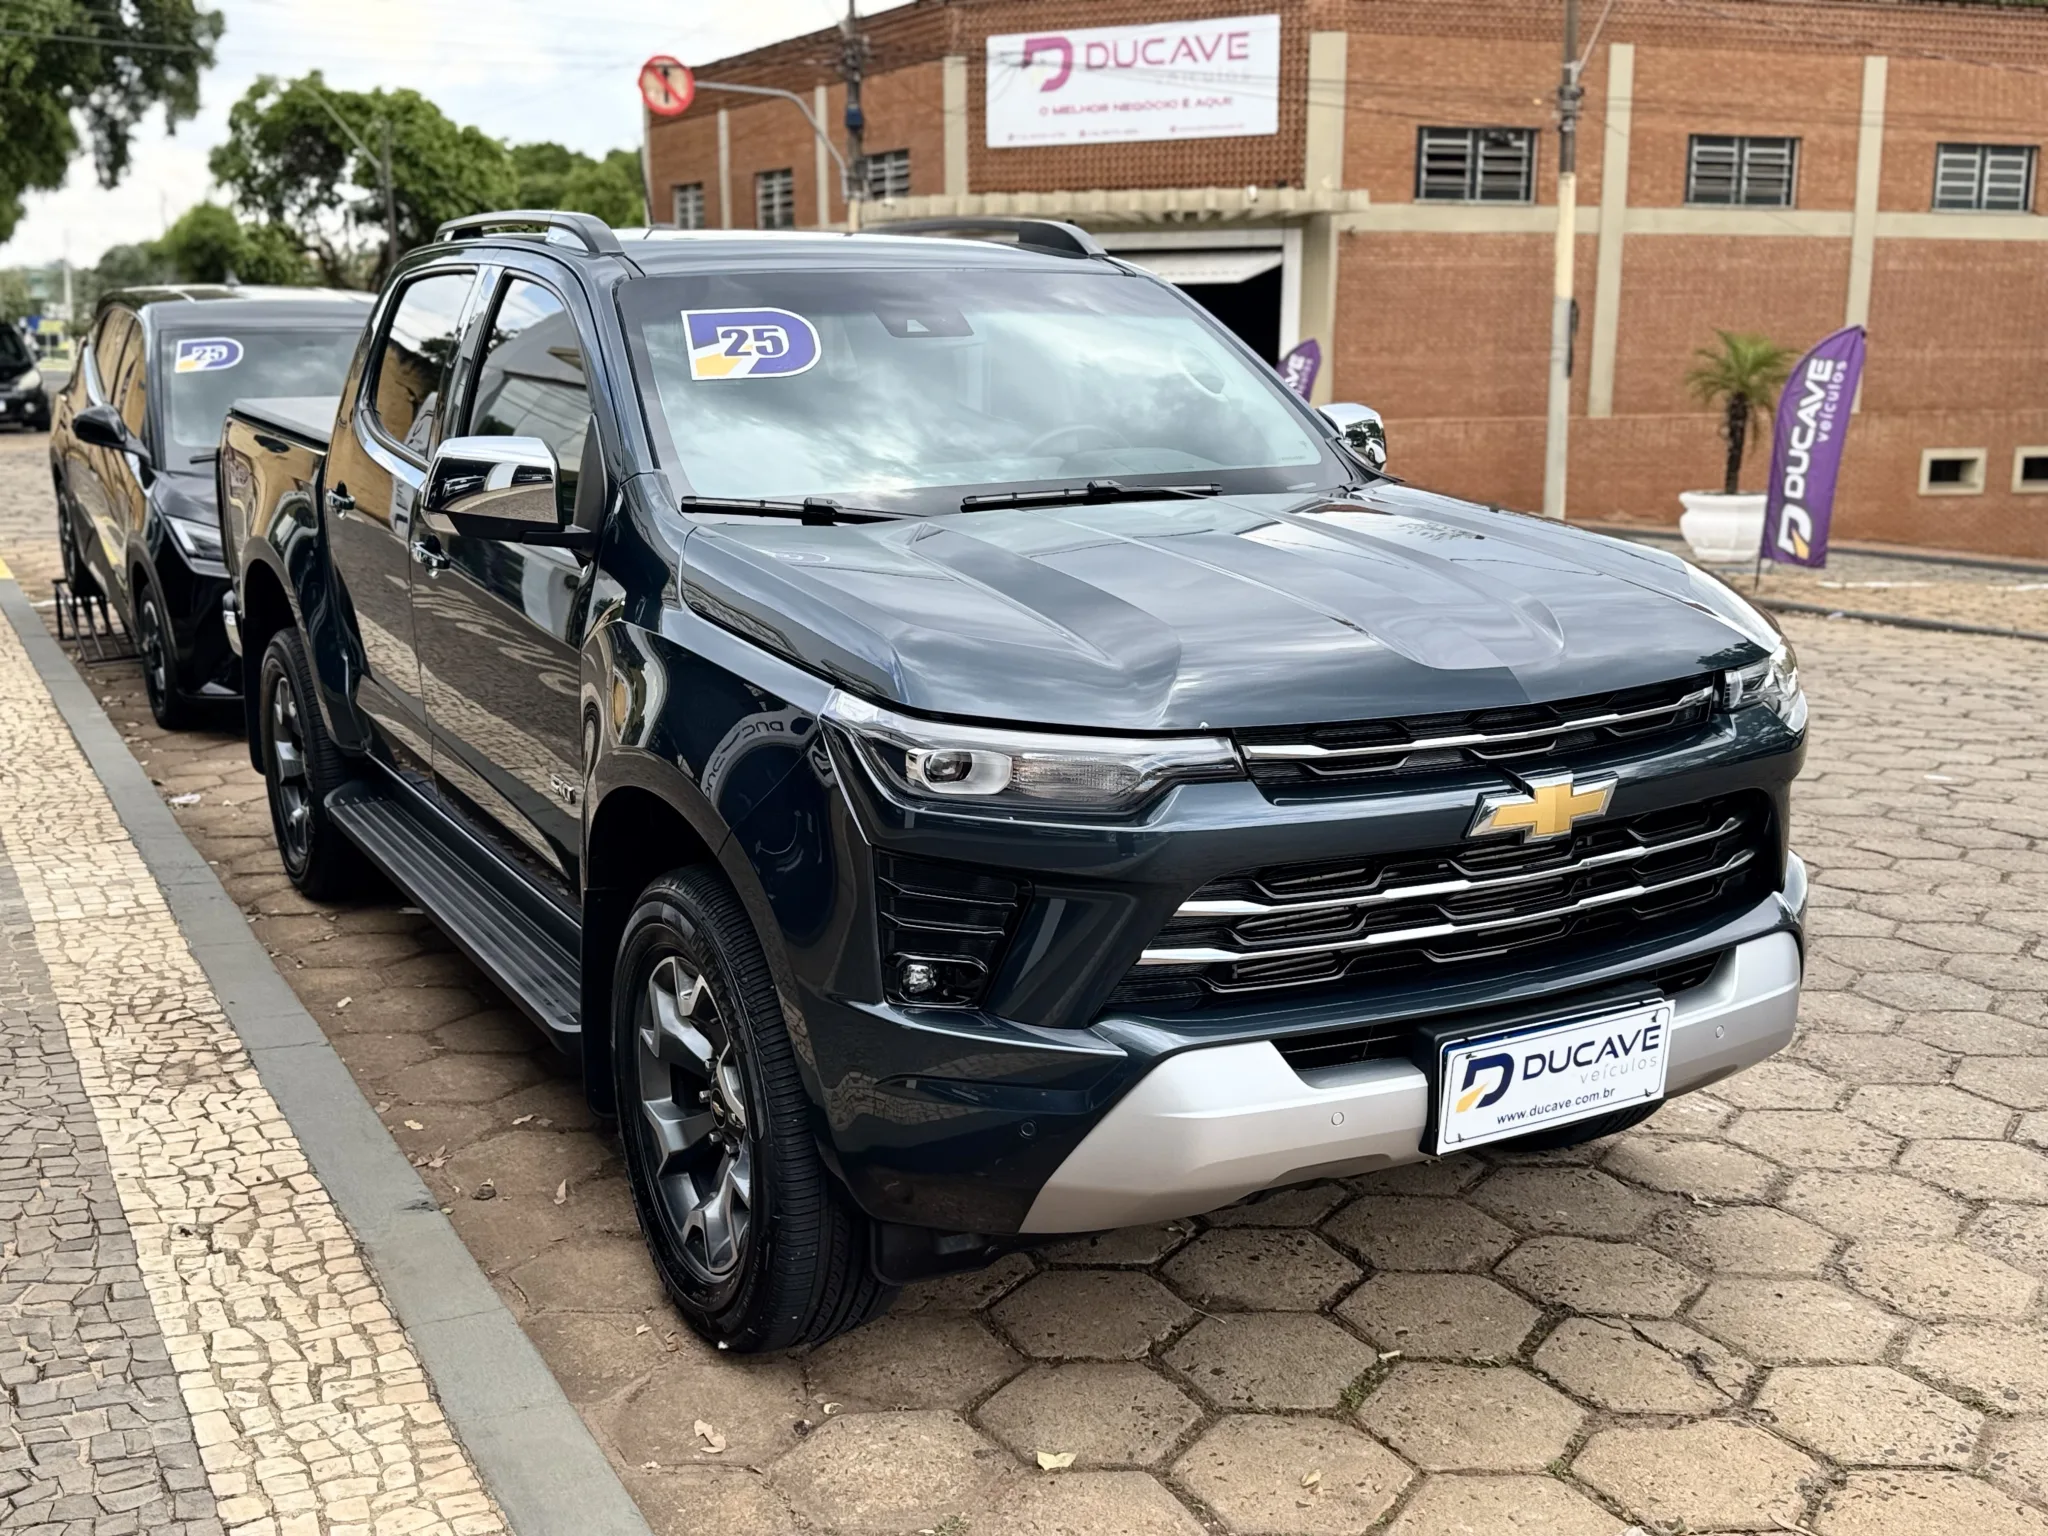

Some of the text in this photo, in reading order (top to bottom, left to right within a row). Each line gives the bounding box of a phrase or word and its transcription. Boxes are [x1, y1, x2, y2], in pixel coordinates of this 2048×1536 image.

[1086, 32, 1249, 70] DUCAVE
[1052, 103, 1109, 115] MELHOR
[194, 347, 224, 362] 25
[721, 328, 784, 357] 25
[1784, 358, 1833, 499] DUCAVE
[1522, 1024, 1661, 1080] DUCAVE
[1580, 1053, 1658, 1084] veículos
[1496, 1086, 1616, 1125] www.ducave.com.br
